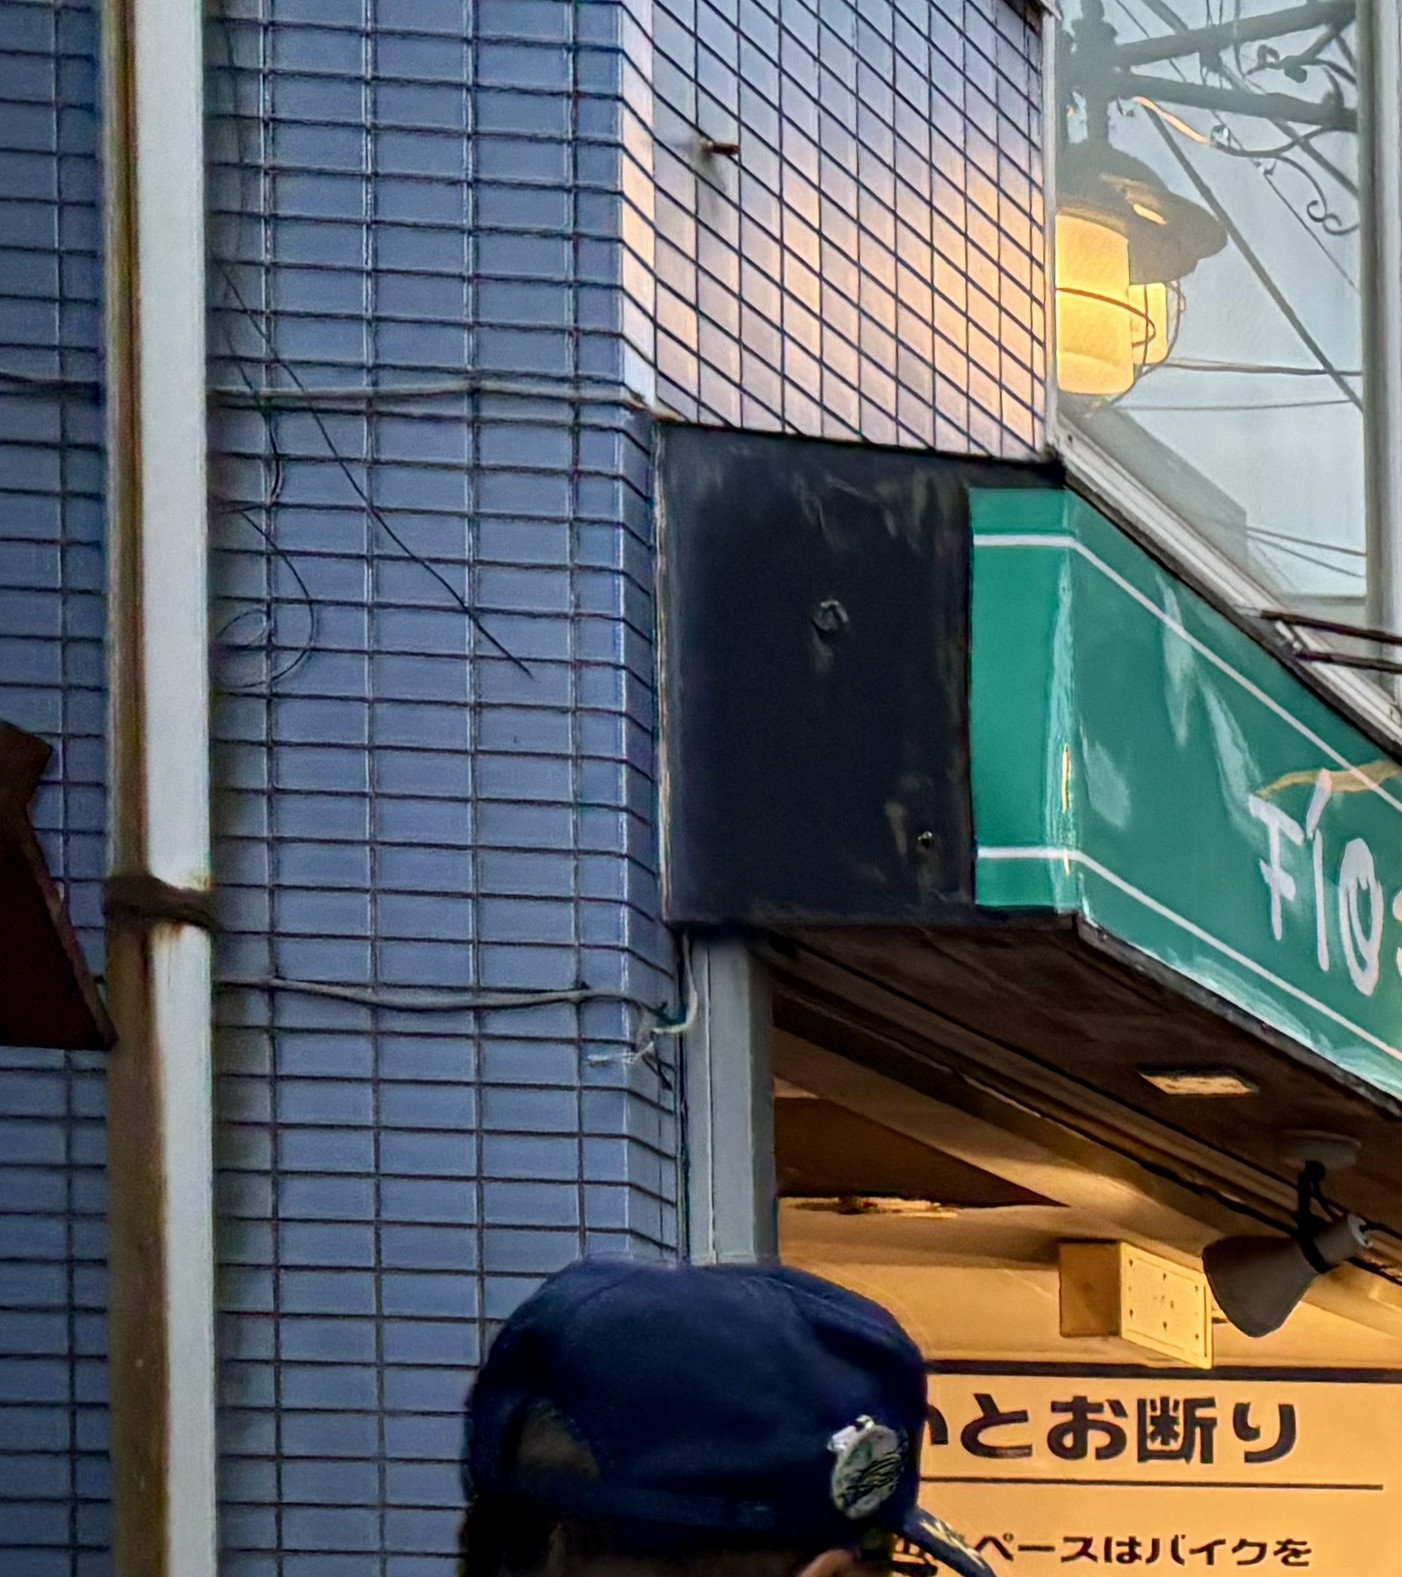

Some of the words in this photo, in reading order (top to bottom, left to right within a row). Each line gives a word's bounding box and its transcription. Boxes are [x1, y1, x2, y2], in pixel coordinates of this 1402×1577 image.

[893, 1532, 1312, 1568] ペースはバイクを
